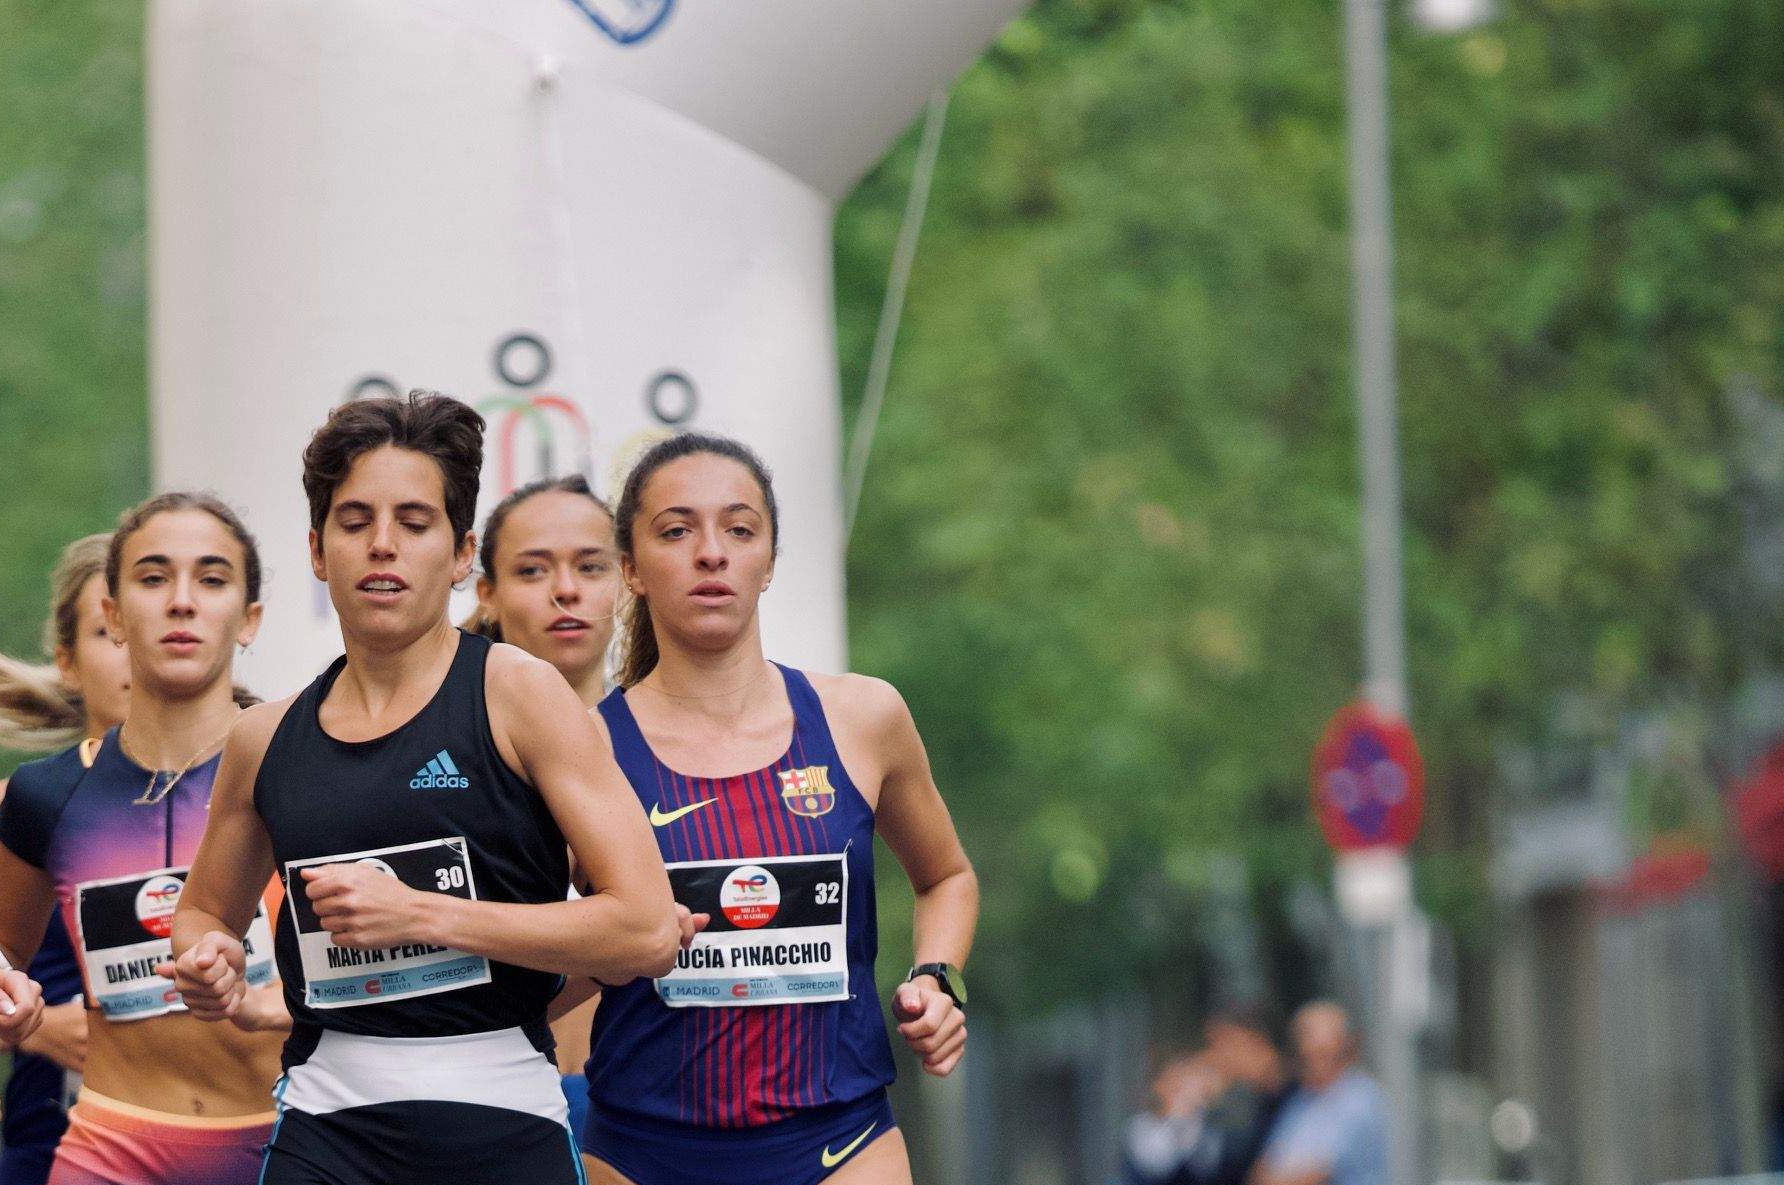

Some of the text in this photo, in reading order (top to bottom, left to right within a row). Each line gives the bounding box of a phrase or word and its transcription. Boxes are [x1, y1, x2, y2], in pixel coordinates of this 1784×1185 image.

[409, 774, 469, 790] adidas
[435, 865, 464, 891] 30
[815, 882, 840, 905] 32
[731, 941, 832, 968] PINACCHIO
[323, 984, 357, 997] MADRID
[676, 984, 720, 997] MADRID
